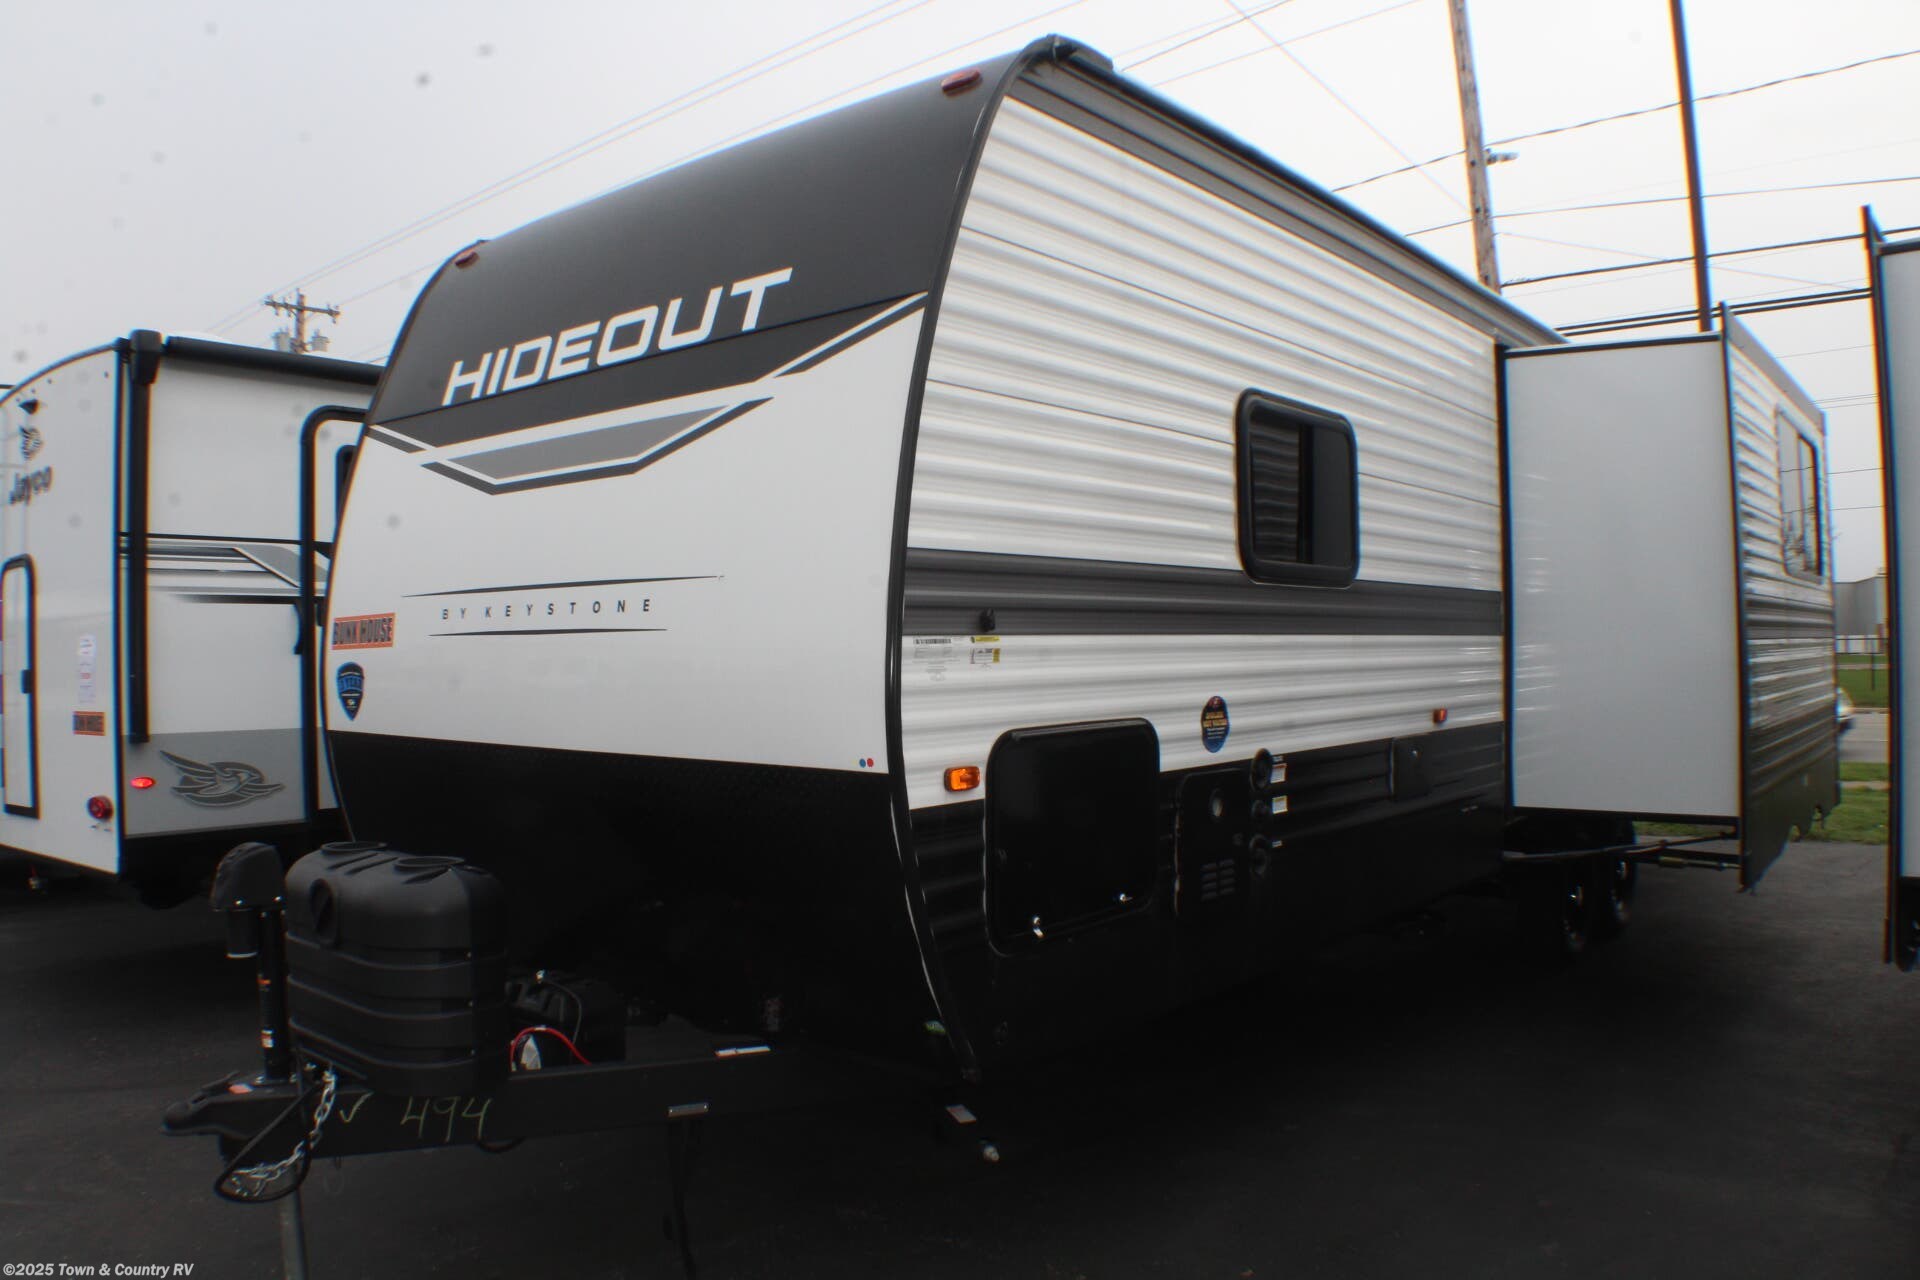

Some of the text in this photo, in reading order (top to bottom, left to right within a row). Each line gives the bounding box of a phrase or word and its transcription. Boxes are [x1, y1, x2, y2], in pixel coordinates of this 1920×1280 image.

[441, 267, 794, 407] HIDEOUT
[442, 598, 651, 620] BY KEYSTONE
[358, 617, 393, 644] HOUSE
[400, 1096, 491, 1142] 494
